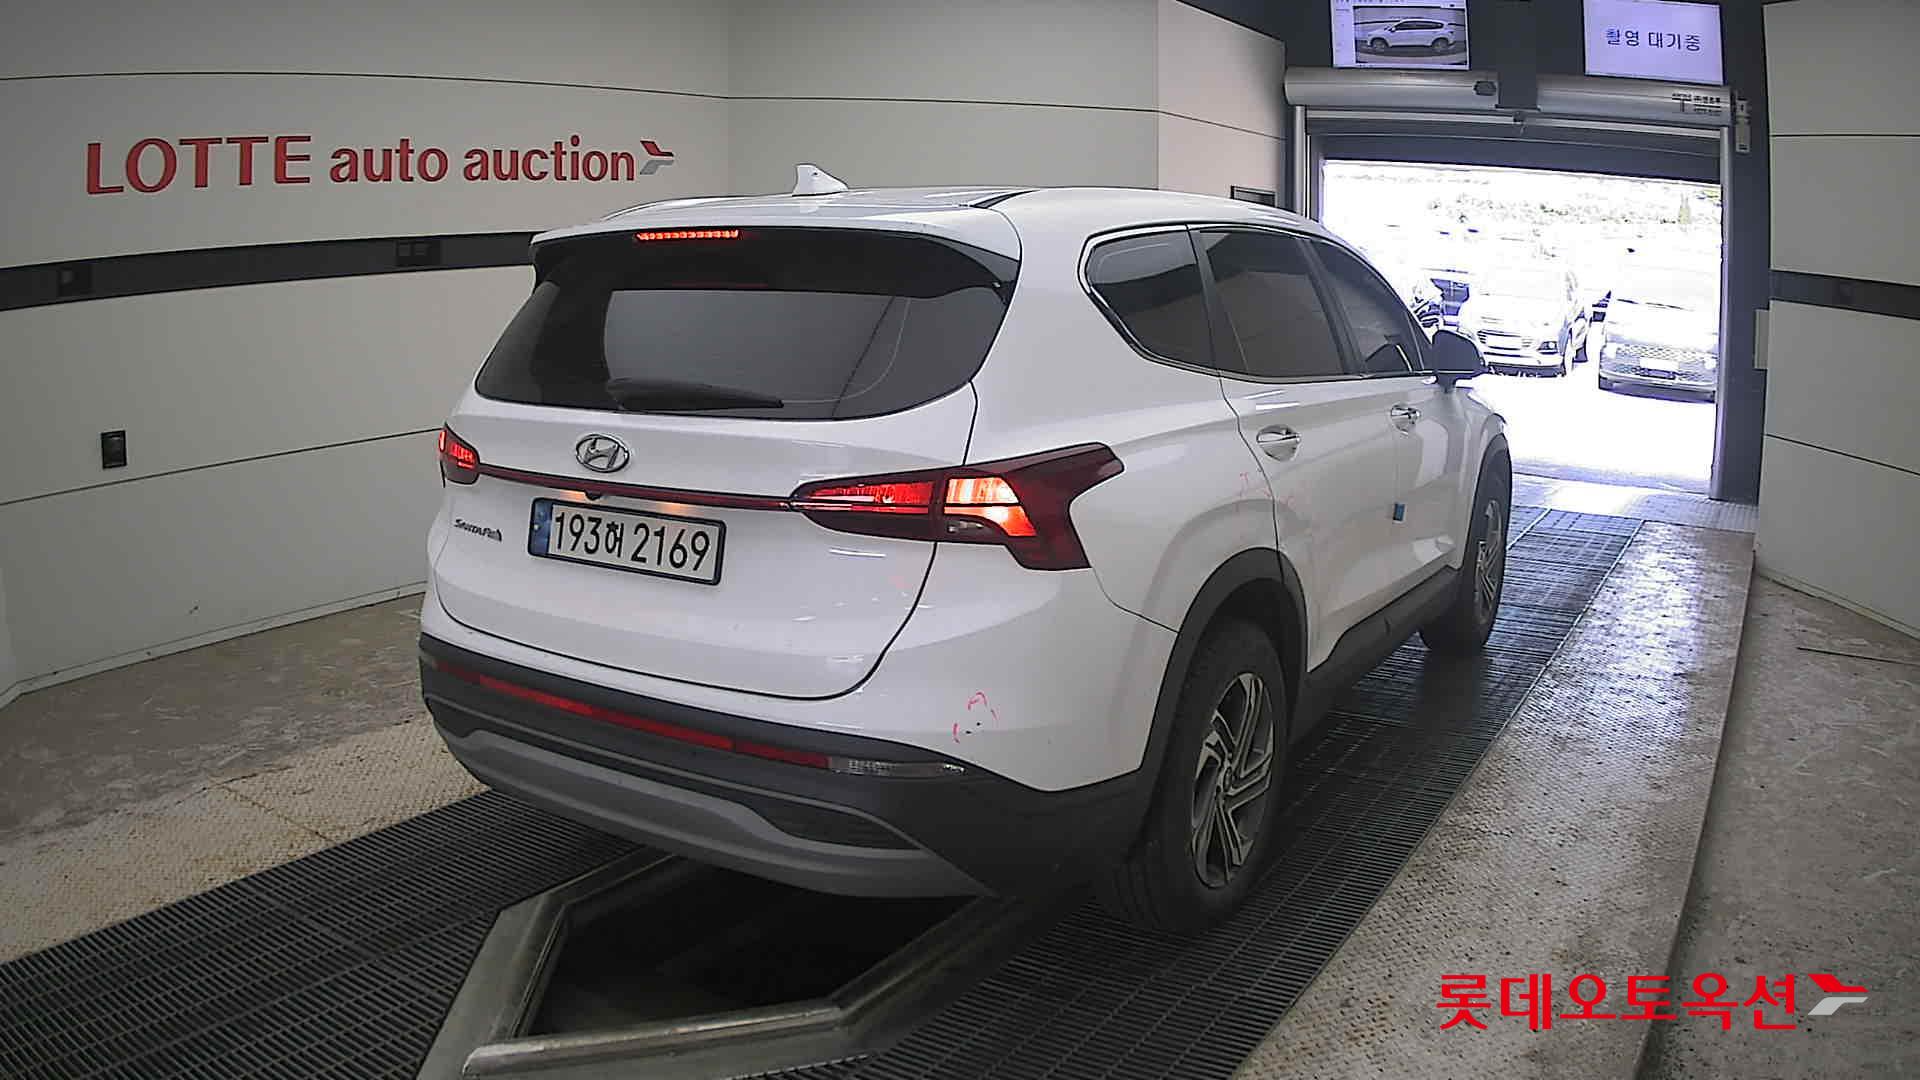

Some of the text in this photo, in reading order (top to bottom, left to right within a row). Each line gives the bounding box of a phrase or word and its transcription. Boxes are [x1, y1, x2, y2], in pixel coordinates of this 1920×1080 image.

[1606, 28, 1701, 52] 촬영 대기중
[86, 135, 636, 195] LOTTE auto auction
[555, 511, 625, 558] 193허
[631, 522, 711, 572] 2169
